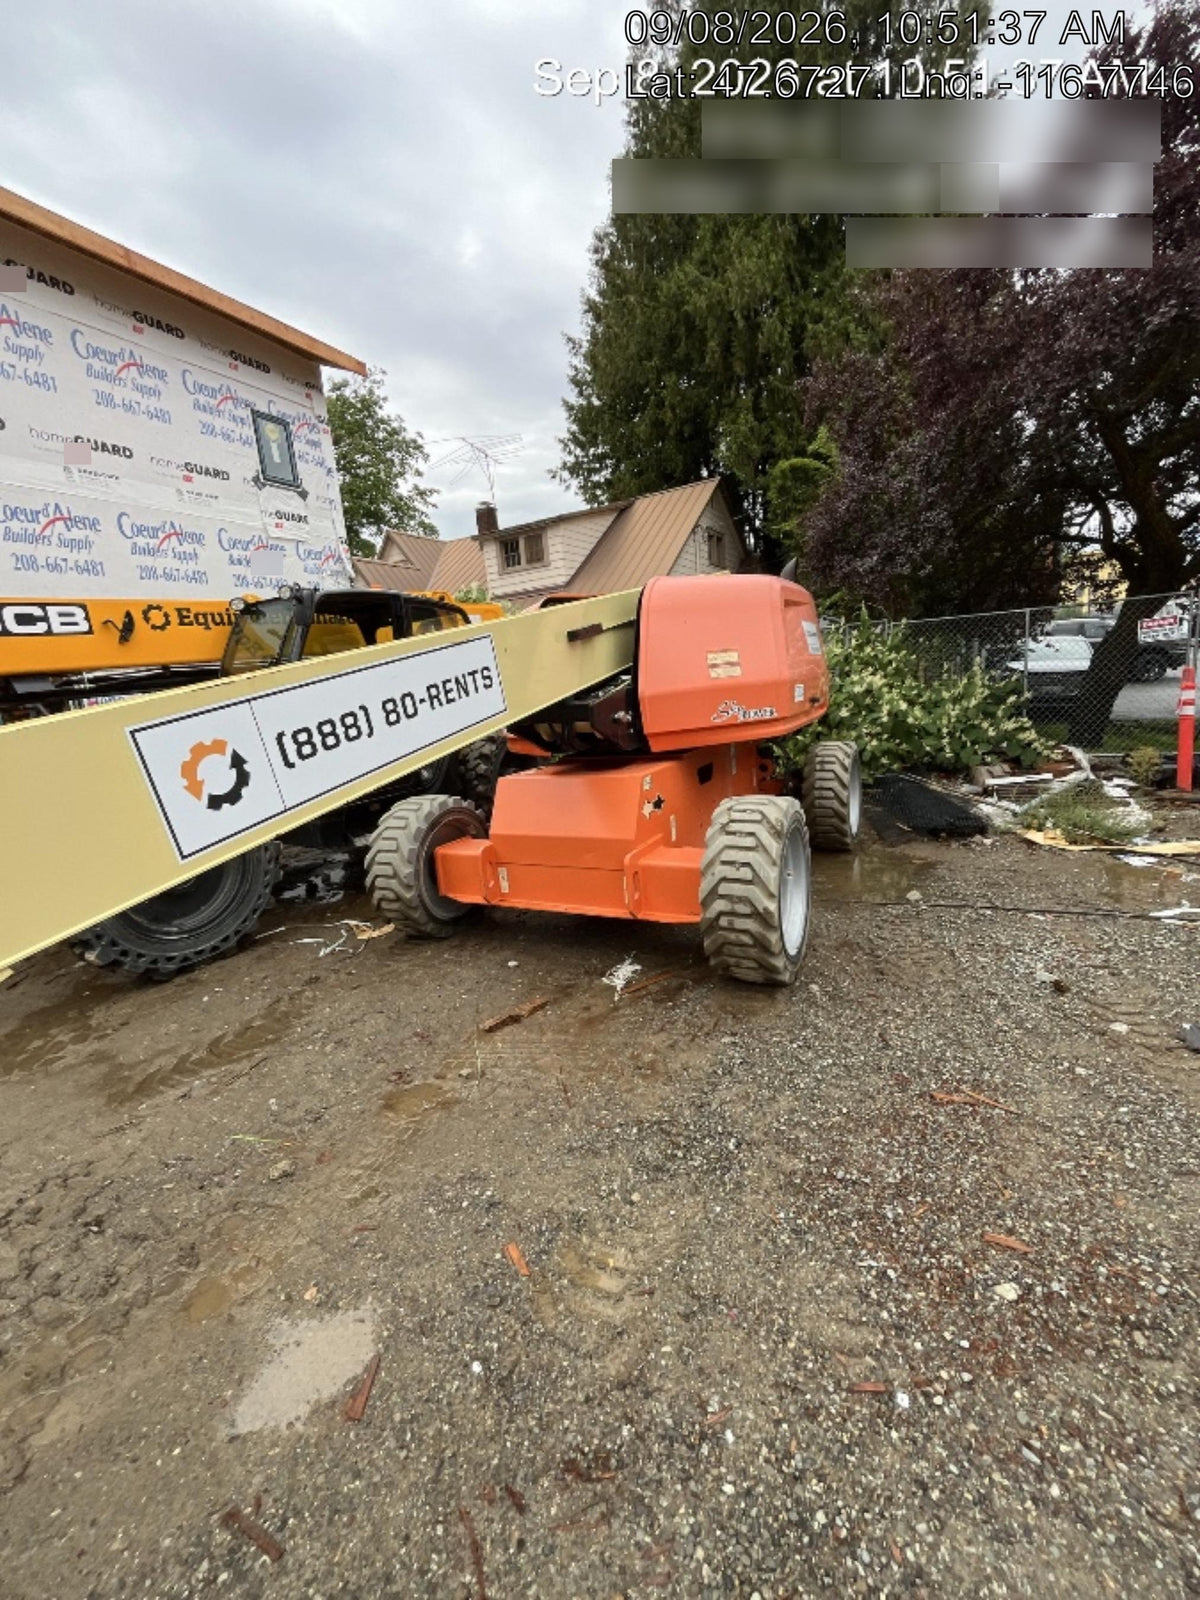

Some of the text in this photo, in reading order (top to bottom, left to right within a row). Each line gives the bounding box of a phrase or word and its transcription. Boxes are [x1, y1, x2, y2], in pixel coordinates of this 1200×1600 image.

[0, 303, 54, 346] Alene
[3, 335, 45, 367] Supply
[0, 360, 58, 394] 67-6481
[0, 503, 41, 525] oeur
[3, 526, 94, 555] Builders Supply
[10, 552, 106, 578] 208-667-6481
[0, 605, 90, 634] CB
[275, 666, 495, 769] (888) 80-RENTS
